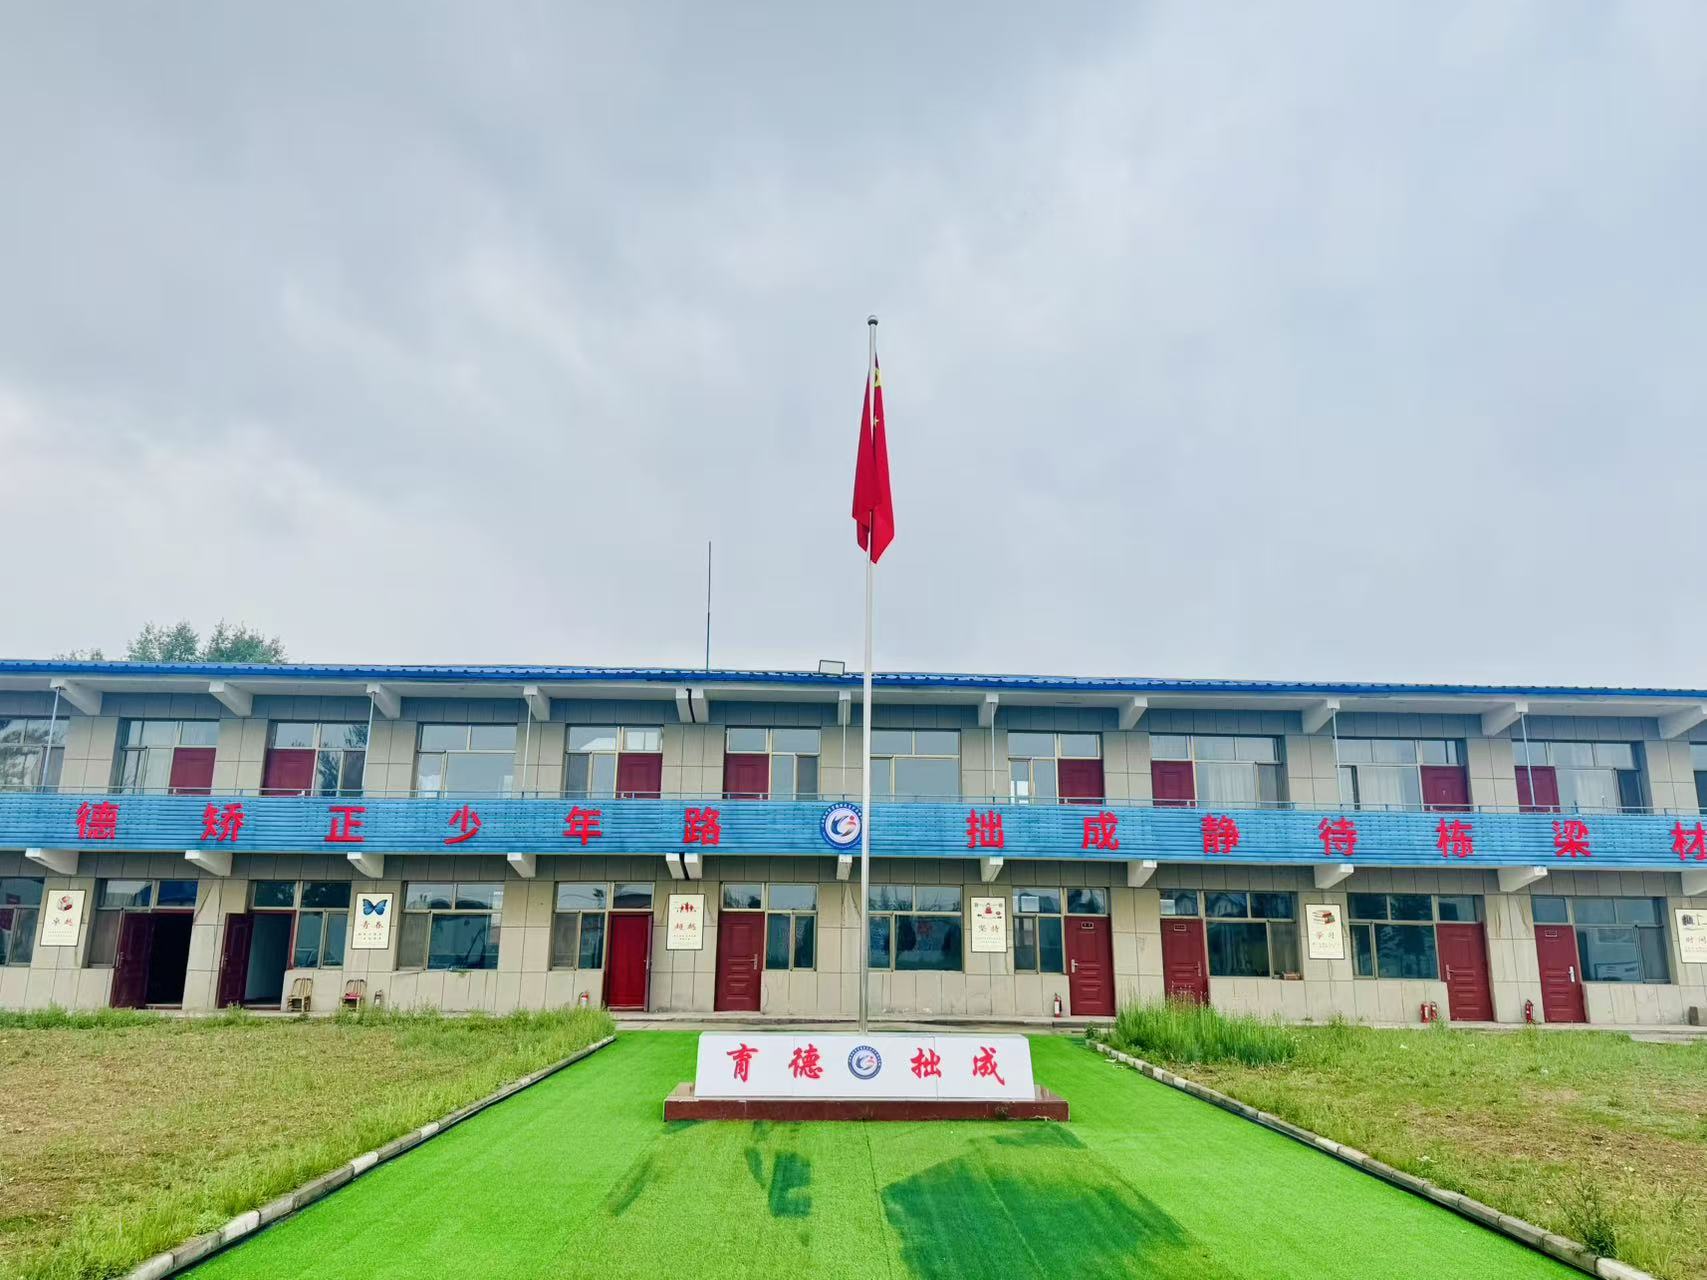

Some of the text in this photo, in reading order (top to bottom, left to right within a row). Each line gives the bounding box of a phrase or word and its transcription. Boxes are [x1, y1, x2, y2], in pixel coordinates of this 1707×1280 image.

[76, 801, 1707, 861] 德矫正少年路 拙成静待栋梁材
[362, 920, 385, 930] 青春
[726, 1043, 824, 1083] 育德
[910, 1046, 1006, 1086] 拙成
